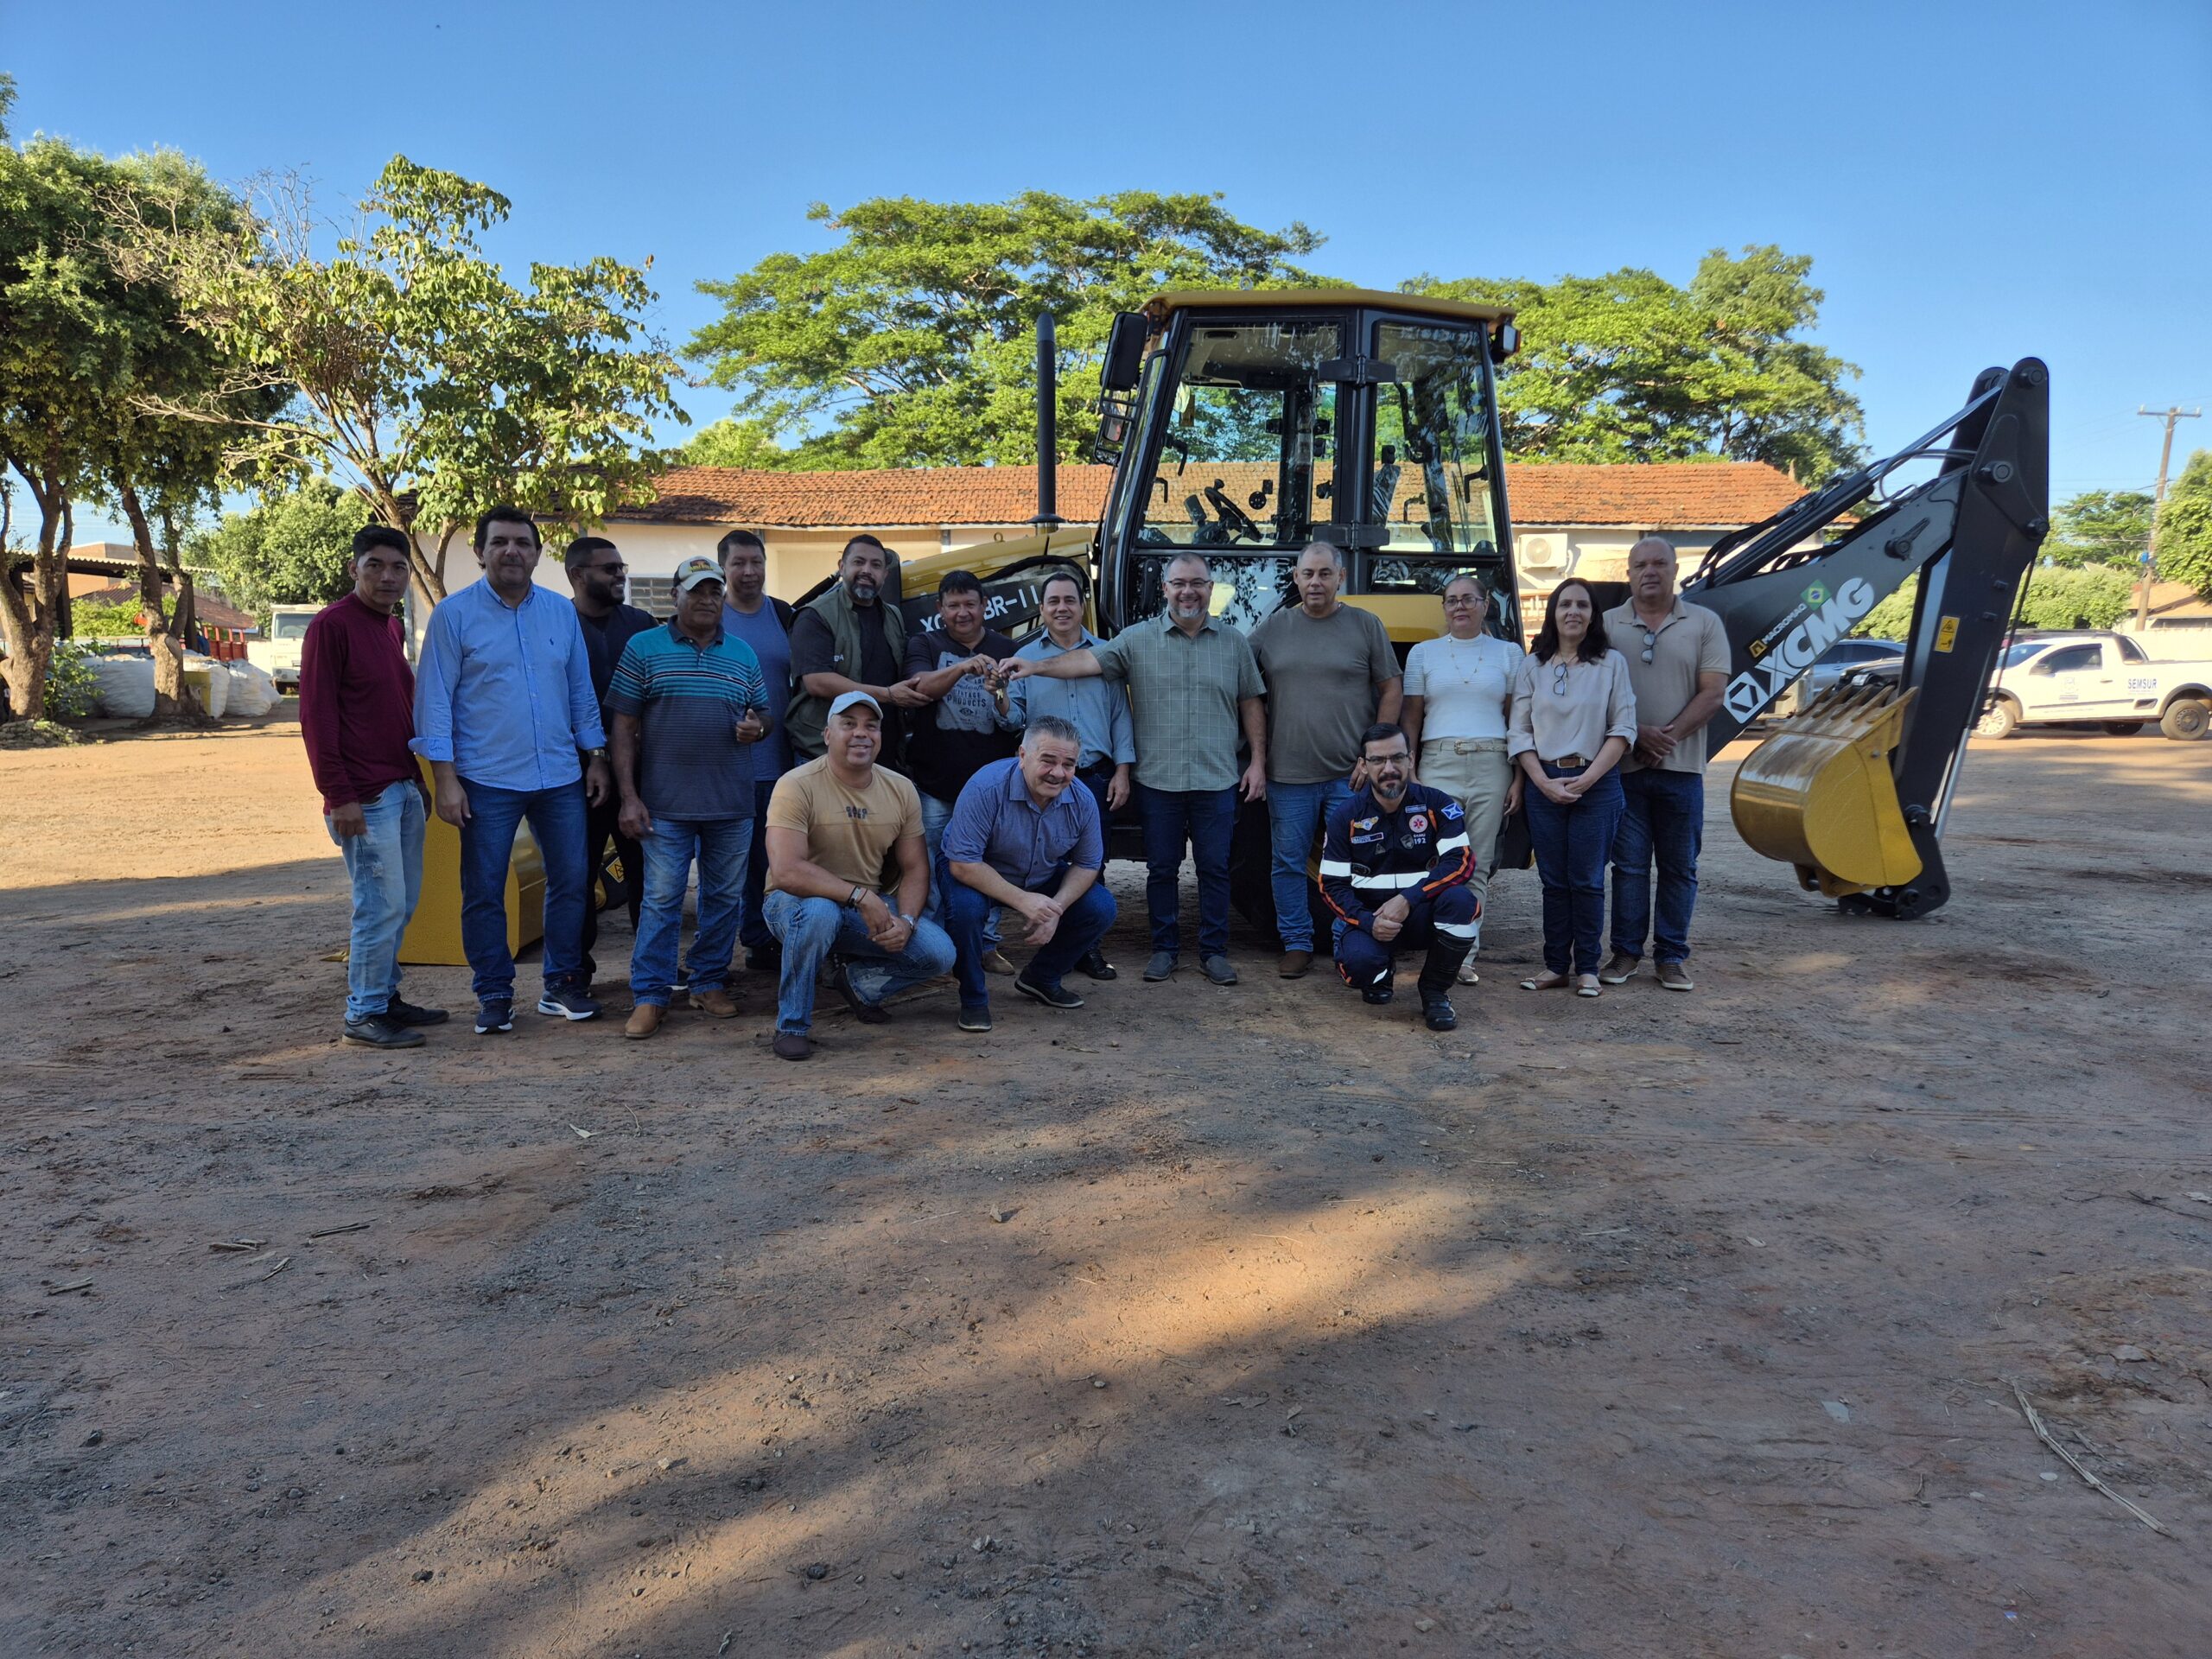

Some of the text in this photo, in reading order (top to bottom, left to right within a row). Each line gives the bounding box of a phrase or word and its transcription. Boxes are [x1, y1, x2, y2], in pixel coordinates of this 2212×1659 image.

[1755, 577, 1874, 698] XCMG
[1762, 603, 1807, 645] MACROMAQ
[2127, 678, 2158, 690] SEMSUR
[1414, 836, 1427, 845] 192
